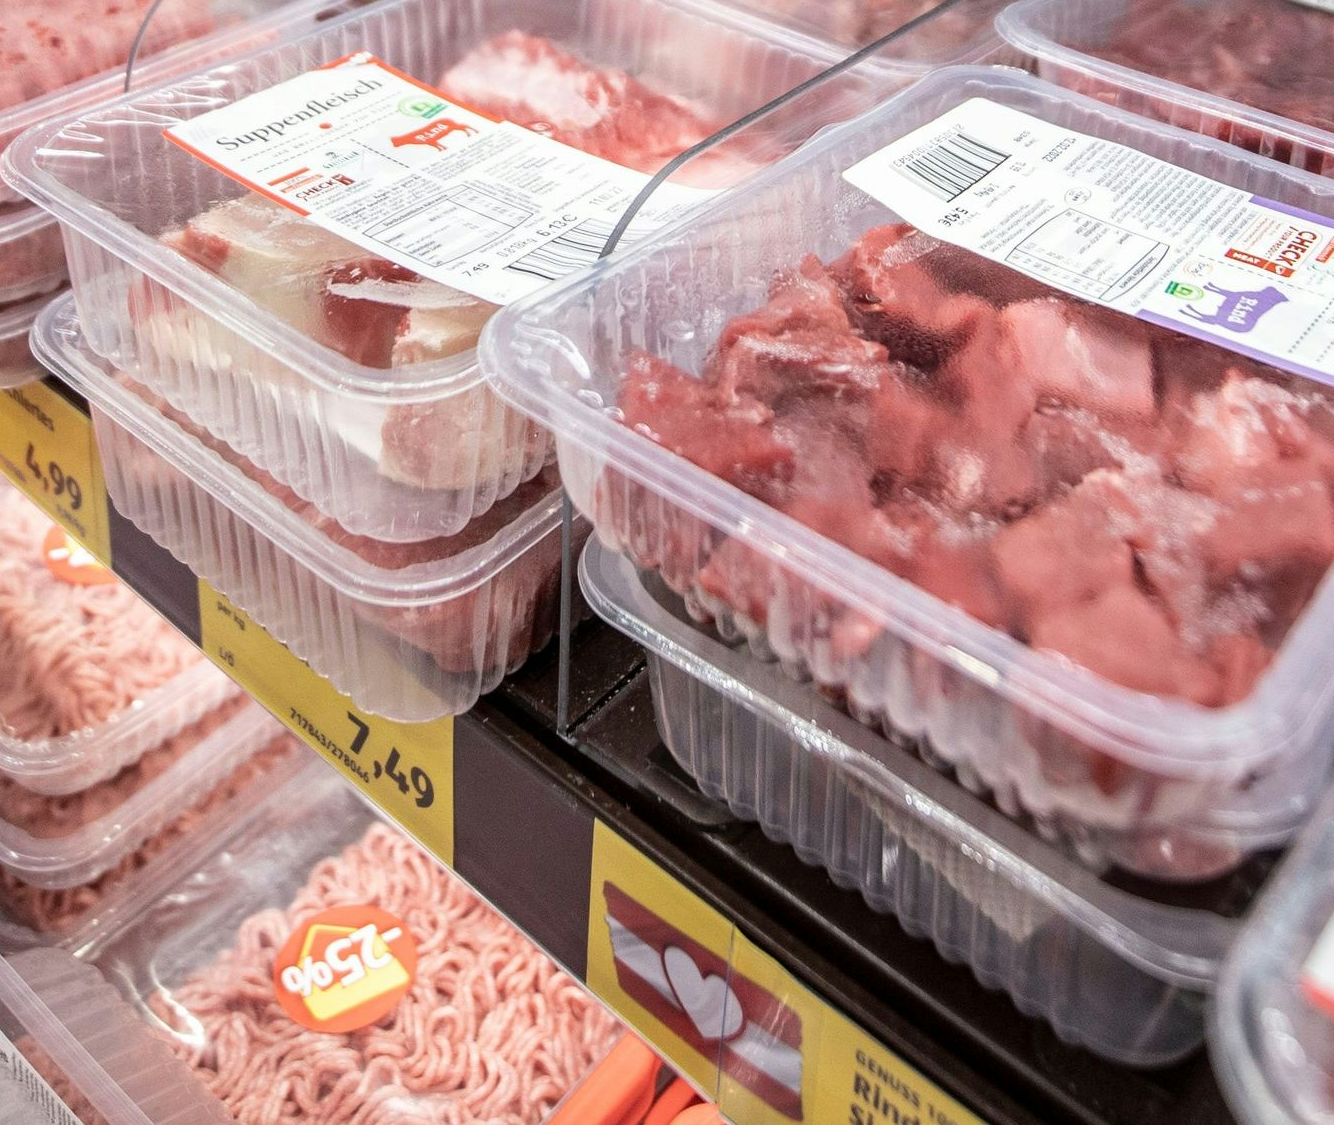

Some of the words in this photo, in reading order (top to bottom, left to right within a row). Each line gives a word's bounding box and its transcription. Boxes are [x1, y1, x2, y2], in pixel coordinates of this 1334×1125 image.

[216, 78, 384, 151] Suppenfleisch
[1275, 230, 1318, 267] CHECK
[1227, 296, 1259, 325] Rind
[25, 442, 83, 510] 4,99
[347, 709, 435, 809] 7,49
[281, 923, 403, 997] -25%
[855, 1049, 920, 1107] GENUSS
